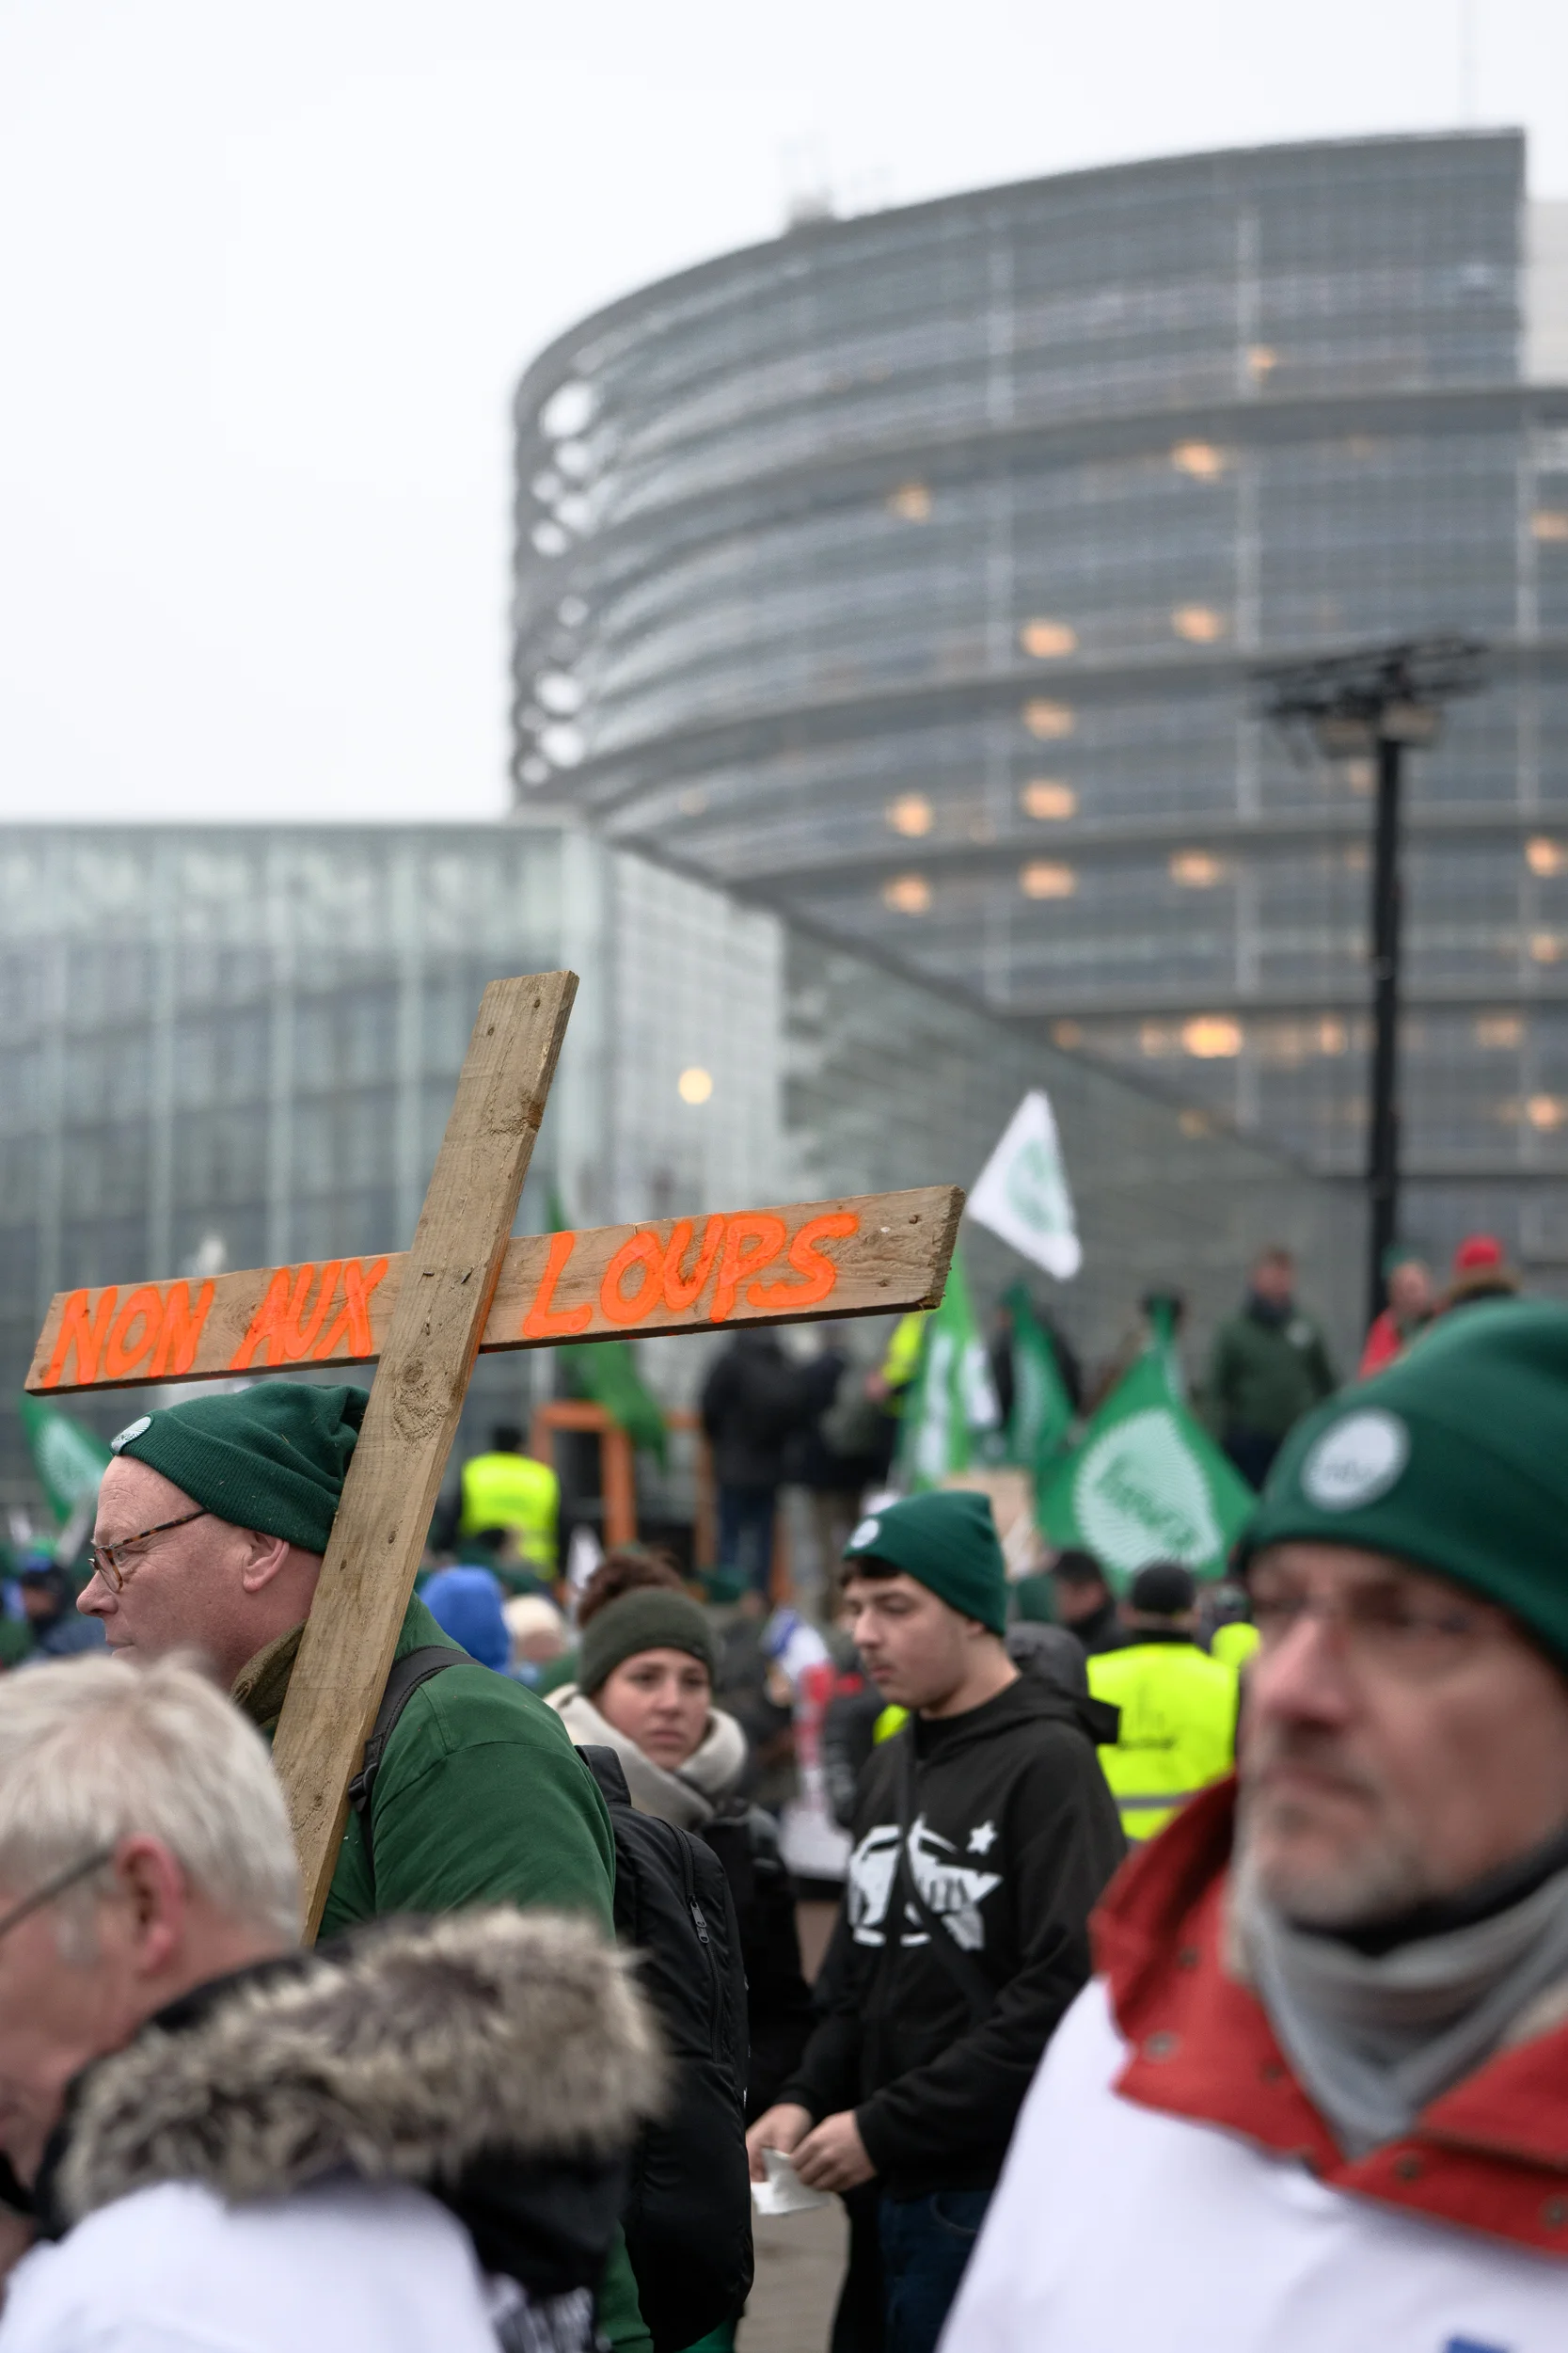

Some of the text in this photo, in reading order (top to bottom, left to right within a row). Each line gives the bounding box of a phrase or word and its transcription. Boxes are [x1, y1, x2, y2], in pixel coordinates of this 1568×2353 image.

[42, 1212, 861, 1389] NON AUX LOUPS
